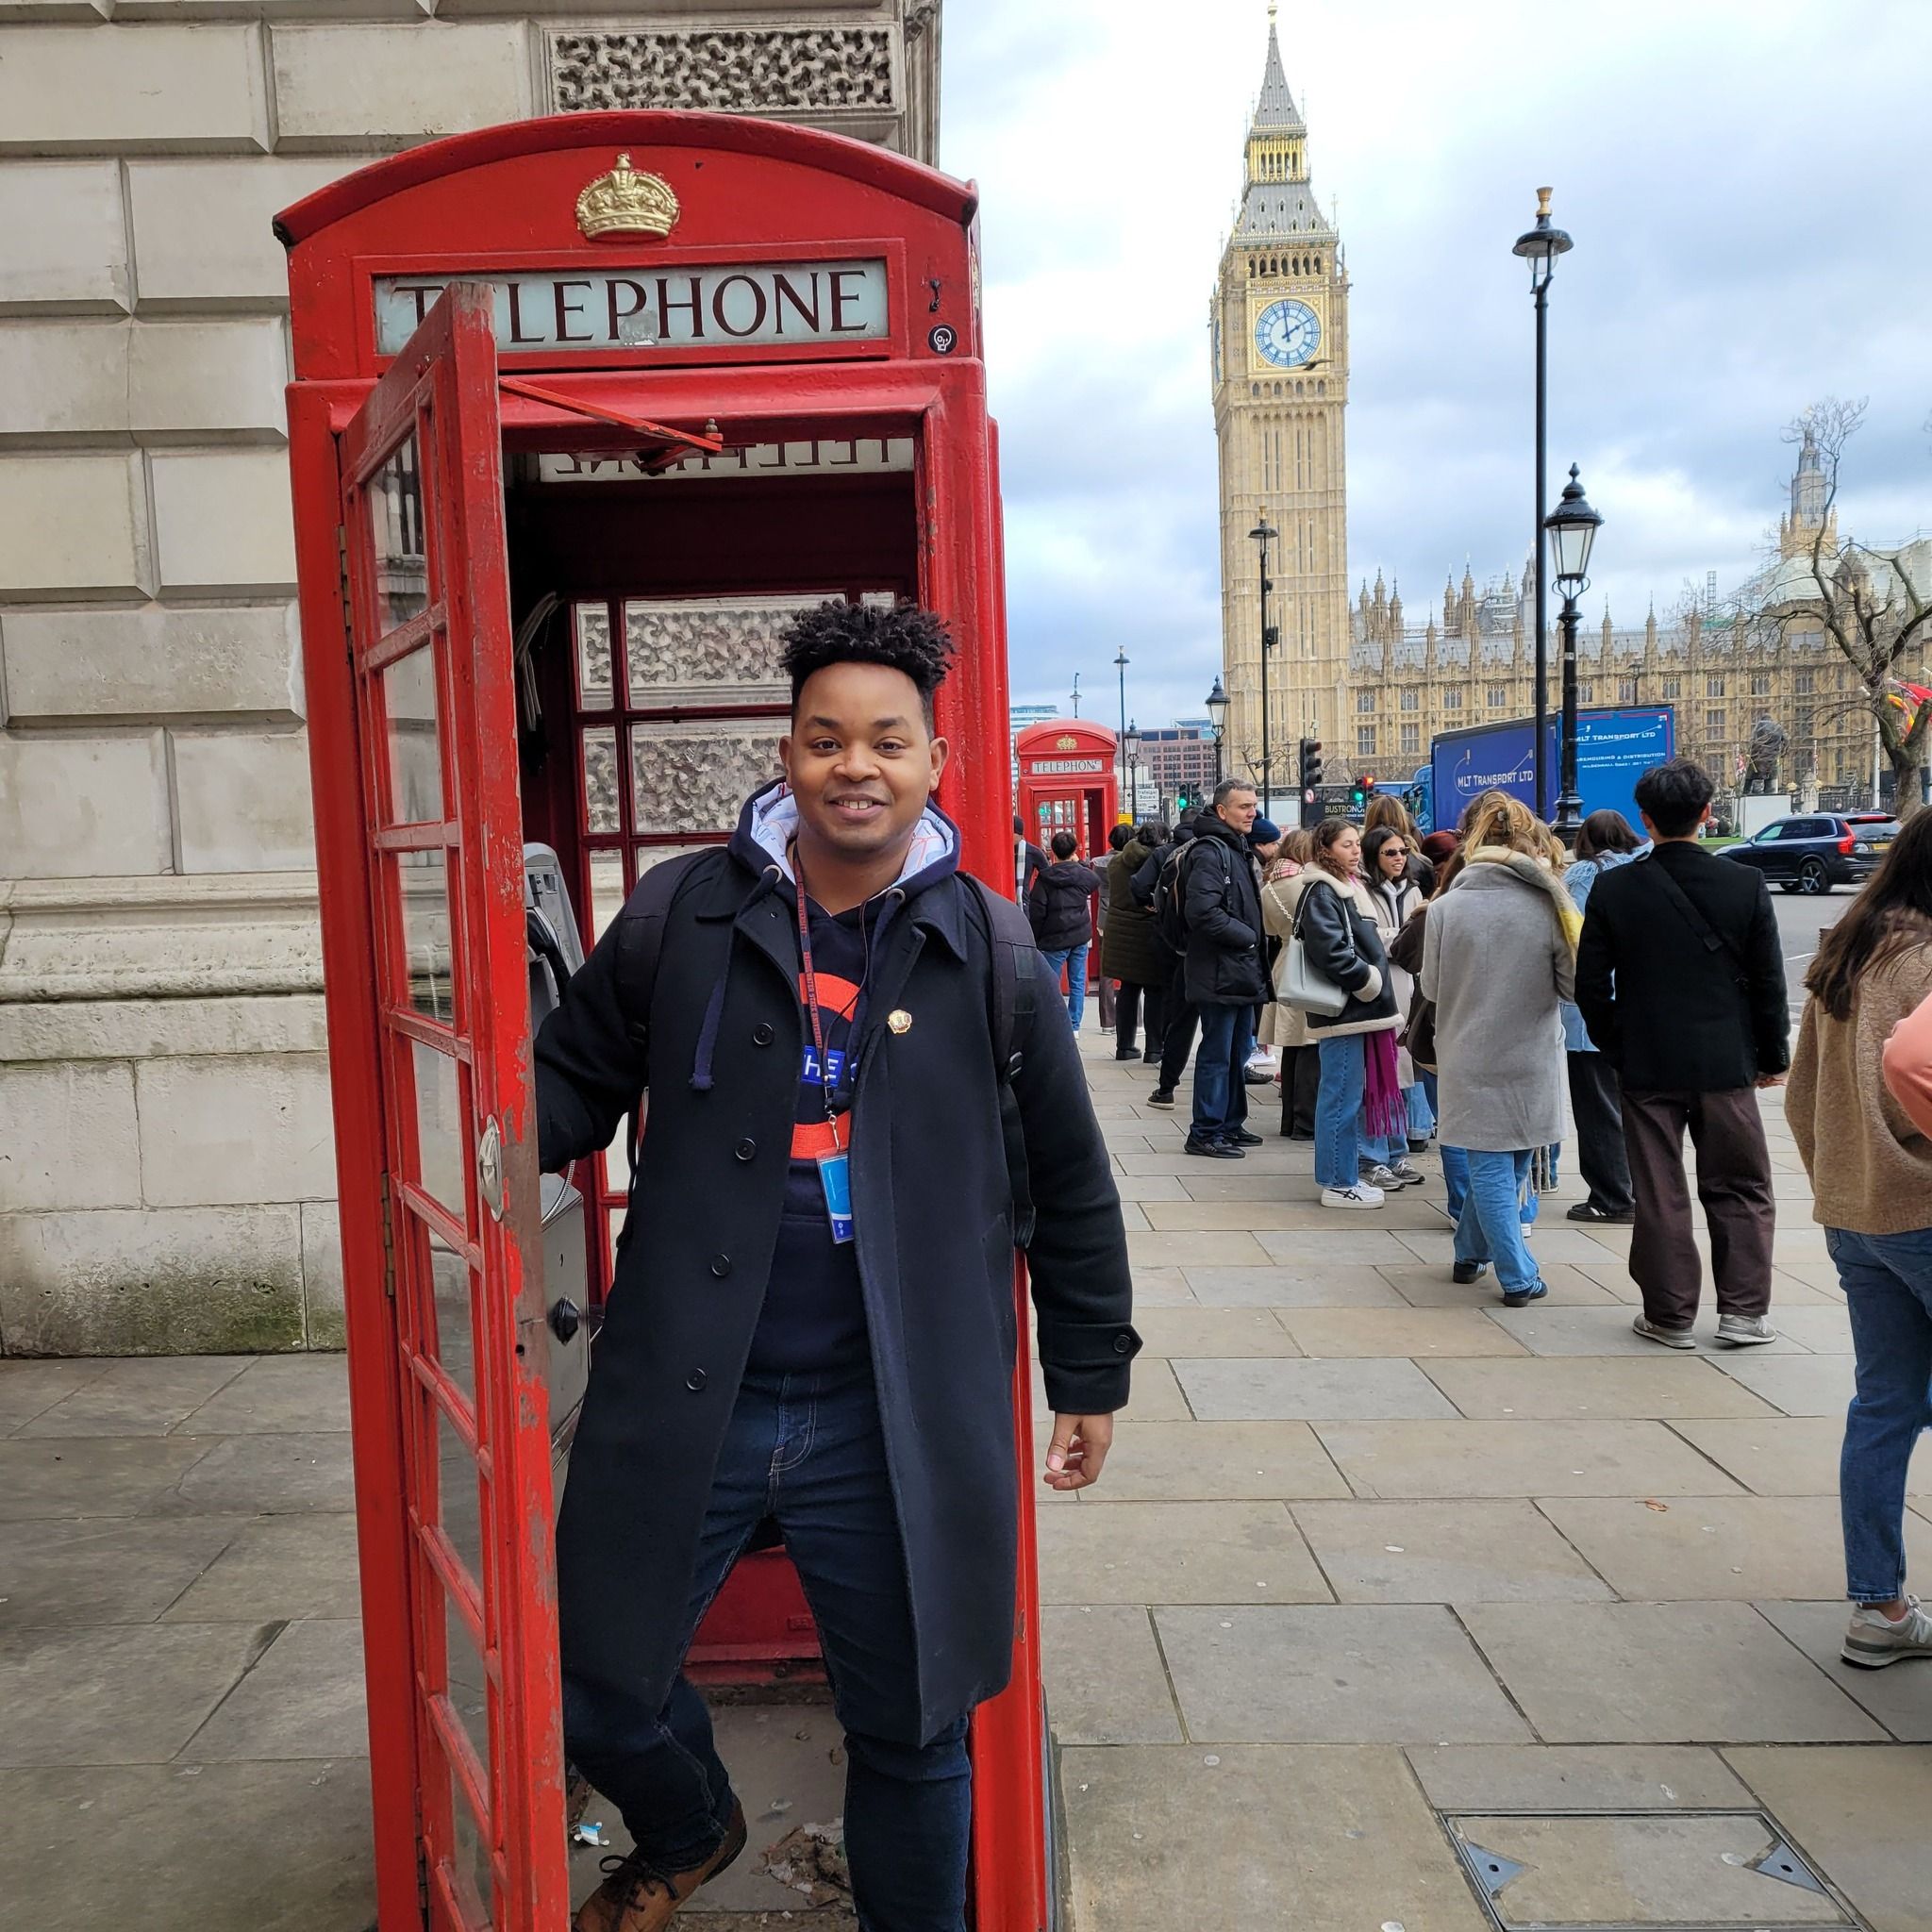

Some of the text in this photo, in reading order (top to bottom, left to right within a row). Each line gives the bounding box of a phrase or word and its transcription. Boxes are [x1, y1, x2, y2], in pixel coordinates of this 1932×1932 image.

[393, 270, 868, 343] TLEPHONE
[1592, 732, 1640, 741] TRANSPORT
[1457, 770, 1534, 788] MLT TRANSPORT LTD
[1324, 805, 1365, 813] BUSTRONO
[804, 1054, 839, 1079] HE
